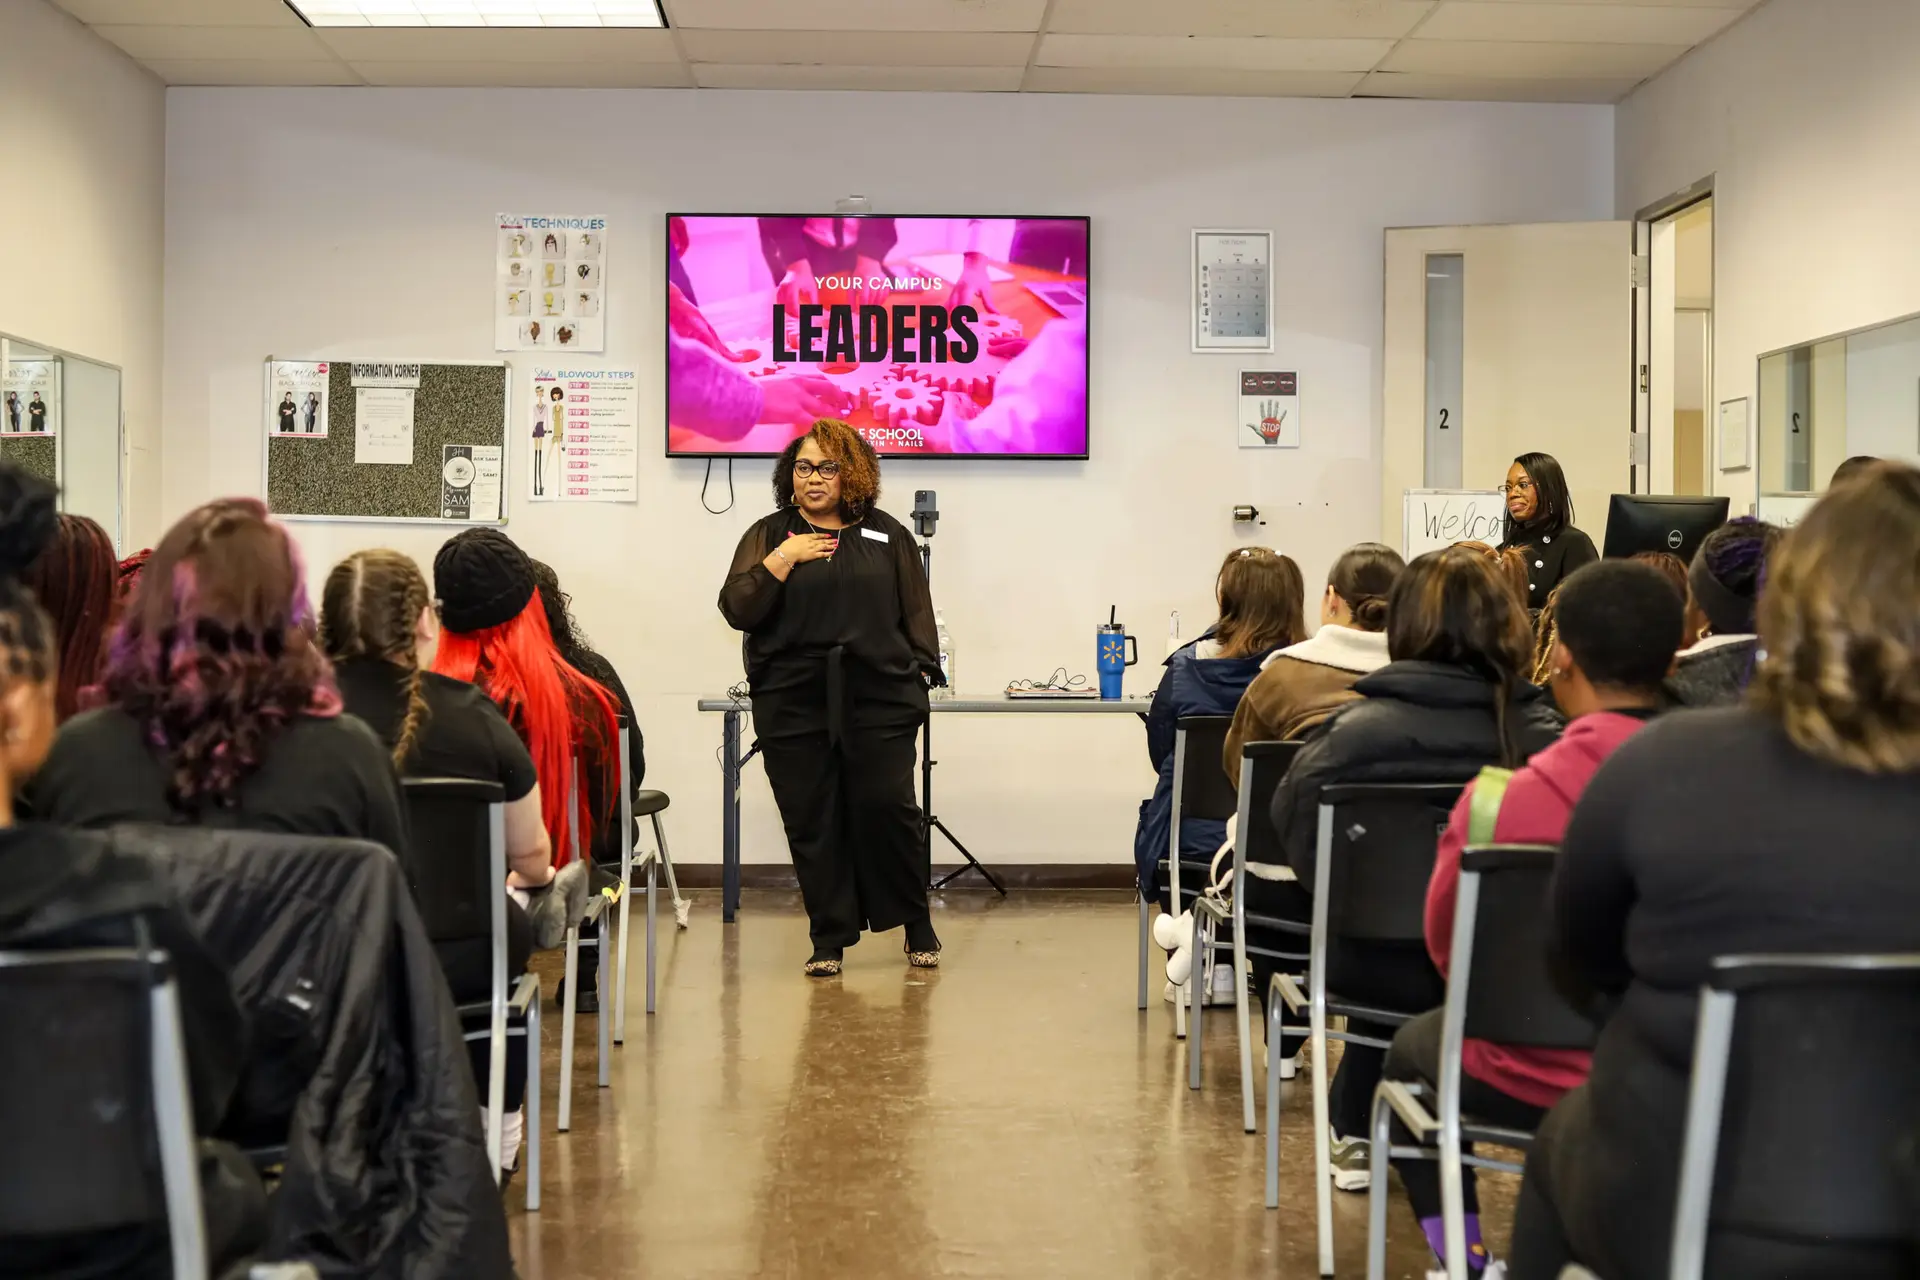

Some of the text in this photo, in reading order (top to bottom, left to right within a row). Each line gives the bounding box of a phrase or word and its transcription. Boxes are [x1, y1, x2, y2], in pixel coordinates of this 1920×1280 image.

[523, 217, 605, 230] TECHNIQUES
[814, 276, 943, 290] YOUR CAMPUS
[773, 304, 979, 364] LEADERS
[351, 363, 420, 378] INFORMATION CORNER
[558, 370, 635, 379] BLOWOUT STEPS
[1440, 408, 1449, 429] 2
[869, 428, 924, 440] SCHOOL
[1262, 422, 1280, 433] STOP
[444, 494, 470, 505] SAM
